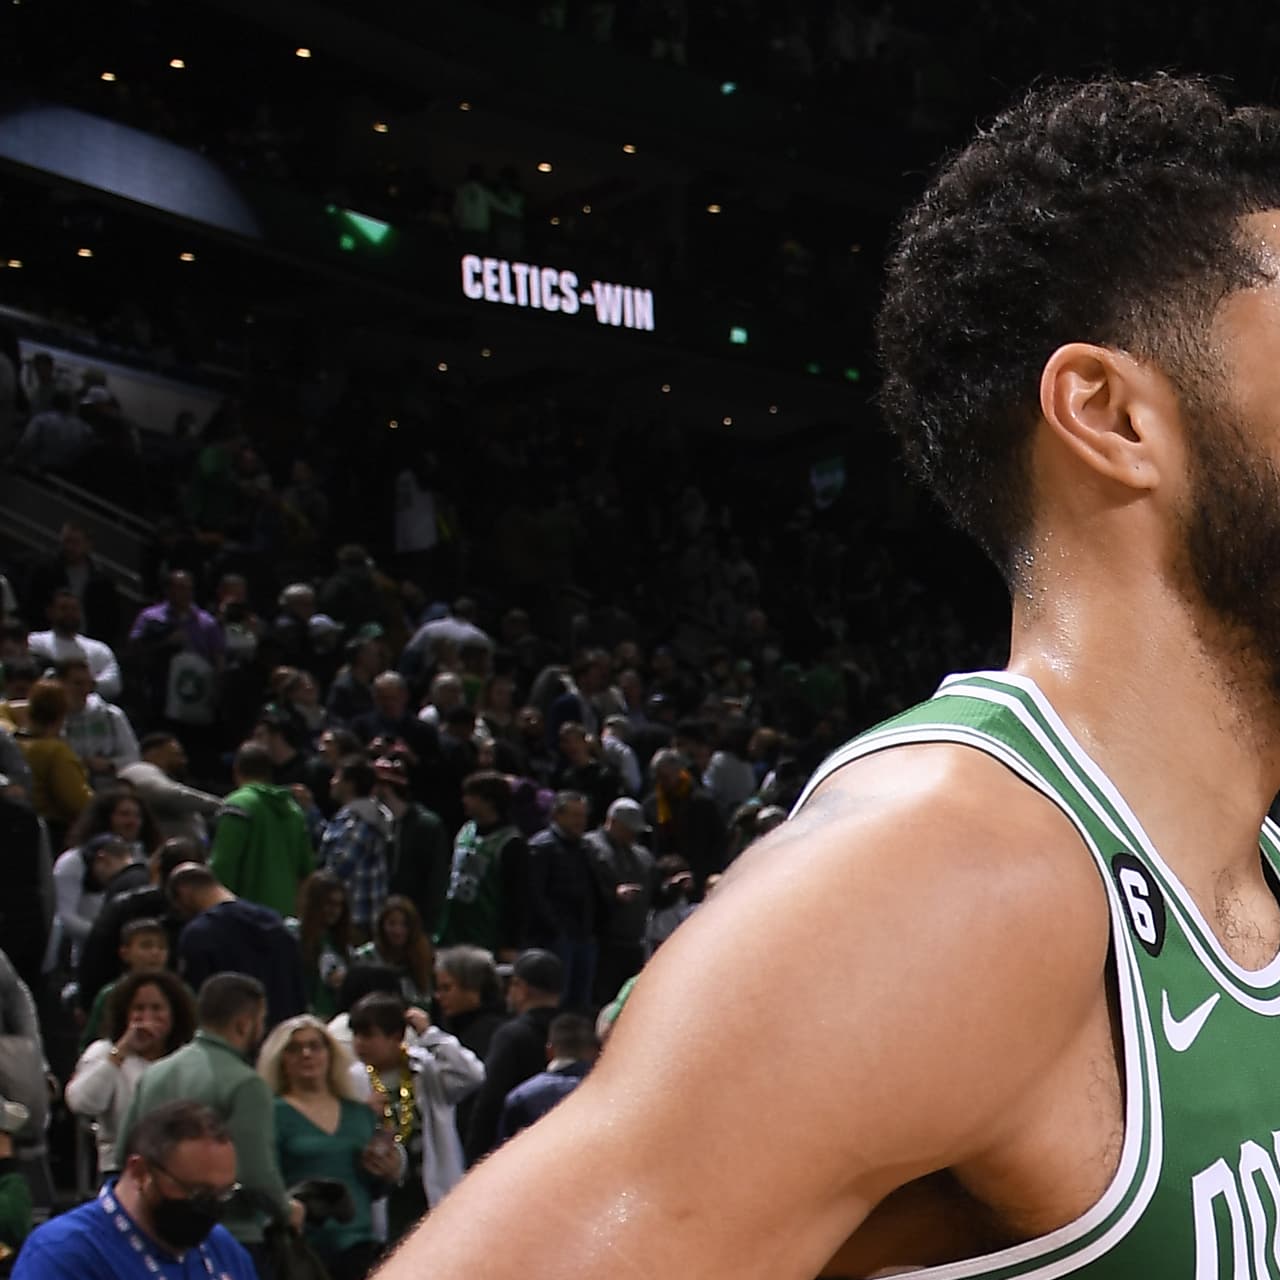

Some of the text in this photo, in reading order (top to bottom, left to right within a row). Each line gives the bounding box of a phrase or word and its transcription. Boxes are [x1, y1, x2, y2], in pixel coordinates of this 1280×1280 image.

[461, 253, 655, 331] CELTICS WIN
[1118, 866, 1158, 946] 6
